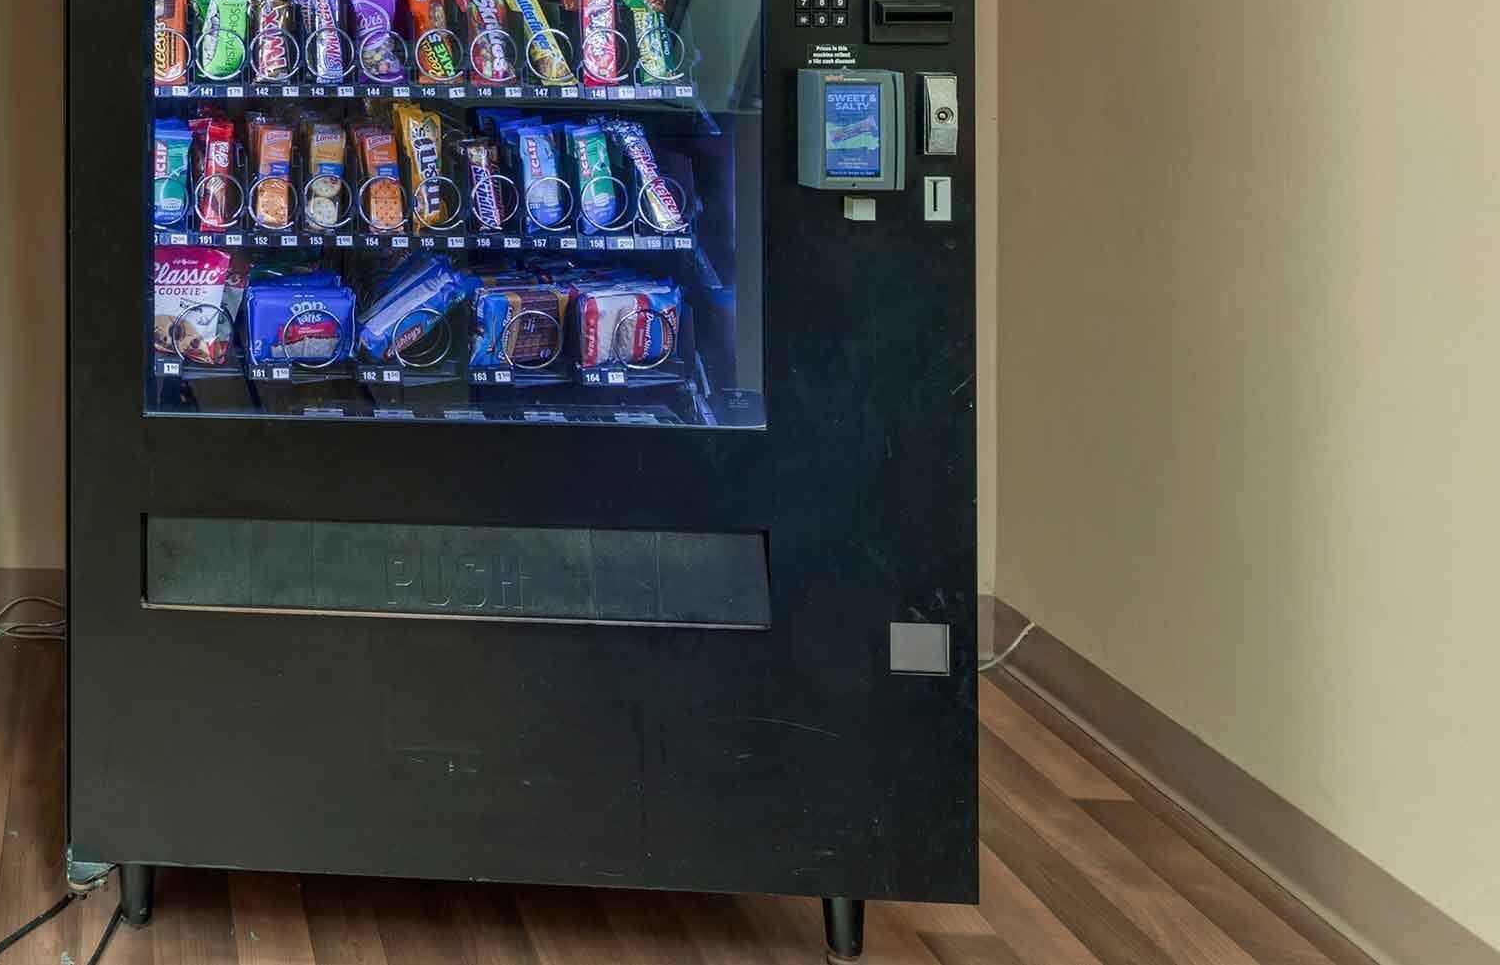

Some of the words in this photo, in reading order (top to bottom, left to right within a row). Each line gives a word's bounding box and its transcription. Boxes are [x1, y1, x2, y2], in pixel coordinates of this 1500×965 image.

[260, 7, 289, 76] TWIX
[200, 88, 213, 96] 141
[256, 88, 269, 96] 142
[311, 88, 325, 96] 143
[367, 88, 381, 96] 144
[422, 88, 436, 96] 145
[478, 88, 492, 96] 146
[534, 88, 549, 96] 147
[592, 90, 606, 98] 148
[828, 94, 867, 103] SWEET
[868, 94, 877, 102] &
[835, 102, 870, 111] SALTY
[316, 131, 340, 143] Lance
[199, 235, 213, 243] 151
[255, 237, 268, 245] 152
[309, 237, 323, 245] 153
[366, 238, 379, 246] 154
[420, 238, 434, 246] 155
[476, 238, 491, 246] 156
[533, 239, 547, 247] 157
[589, 239, 604, 247] 158
[158, 287, 201, 296] COOKIE
[645, 312, 654, 339] Donut
[251, 370, 265, 378] 161
[362, 371, 376, 380] 162
[472, 372, 487, 381] 163
[586, 373, 600, 382] 164
